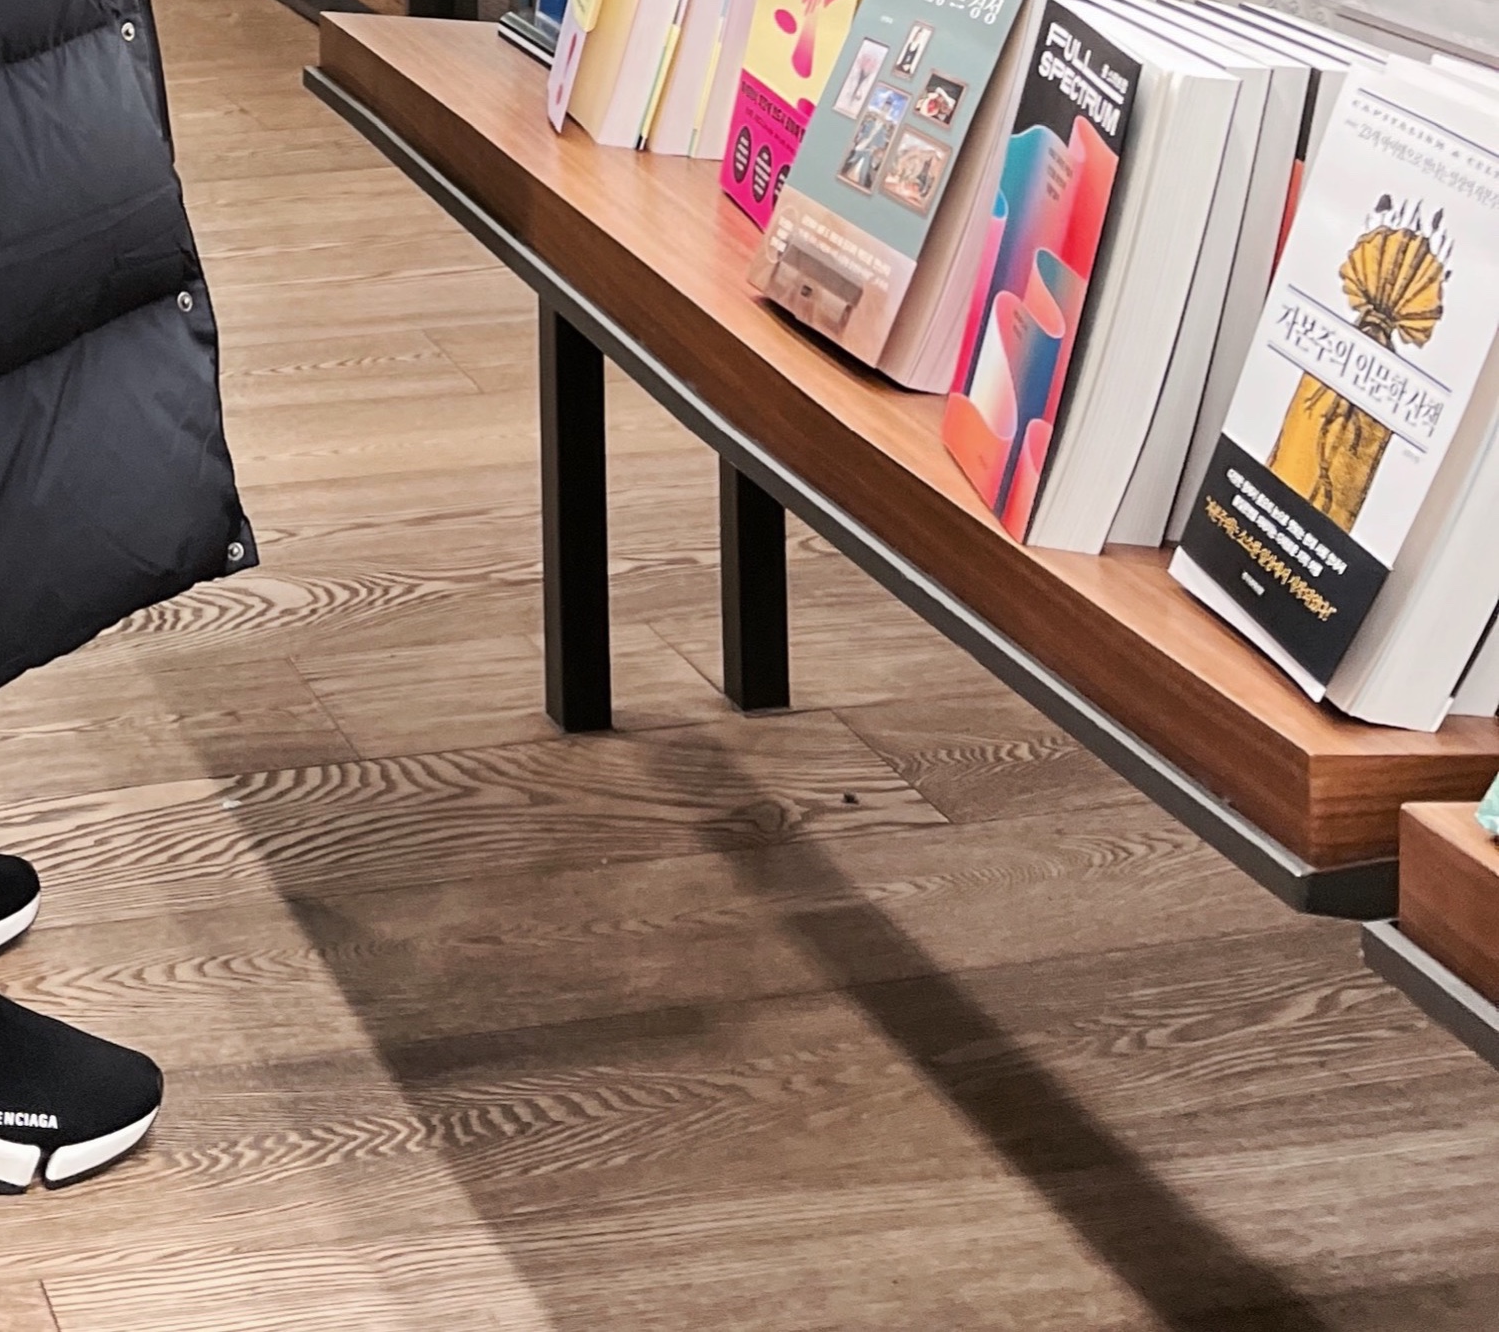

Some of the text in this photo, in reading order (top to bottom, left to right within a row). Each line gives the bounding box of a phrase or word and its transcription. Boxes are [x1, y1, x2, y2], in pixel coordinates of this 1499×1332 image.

[1037, 50, 1122, 137] SPECTRUM
[1045, 21, 1125, 106] FULL
[1275, 304, 1445, 439] 자본주의 인문학 산책
